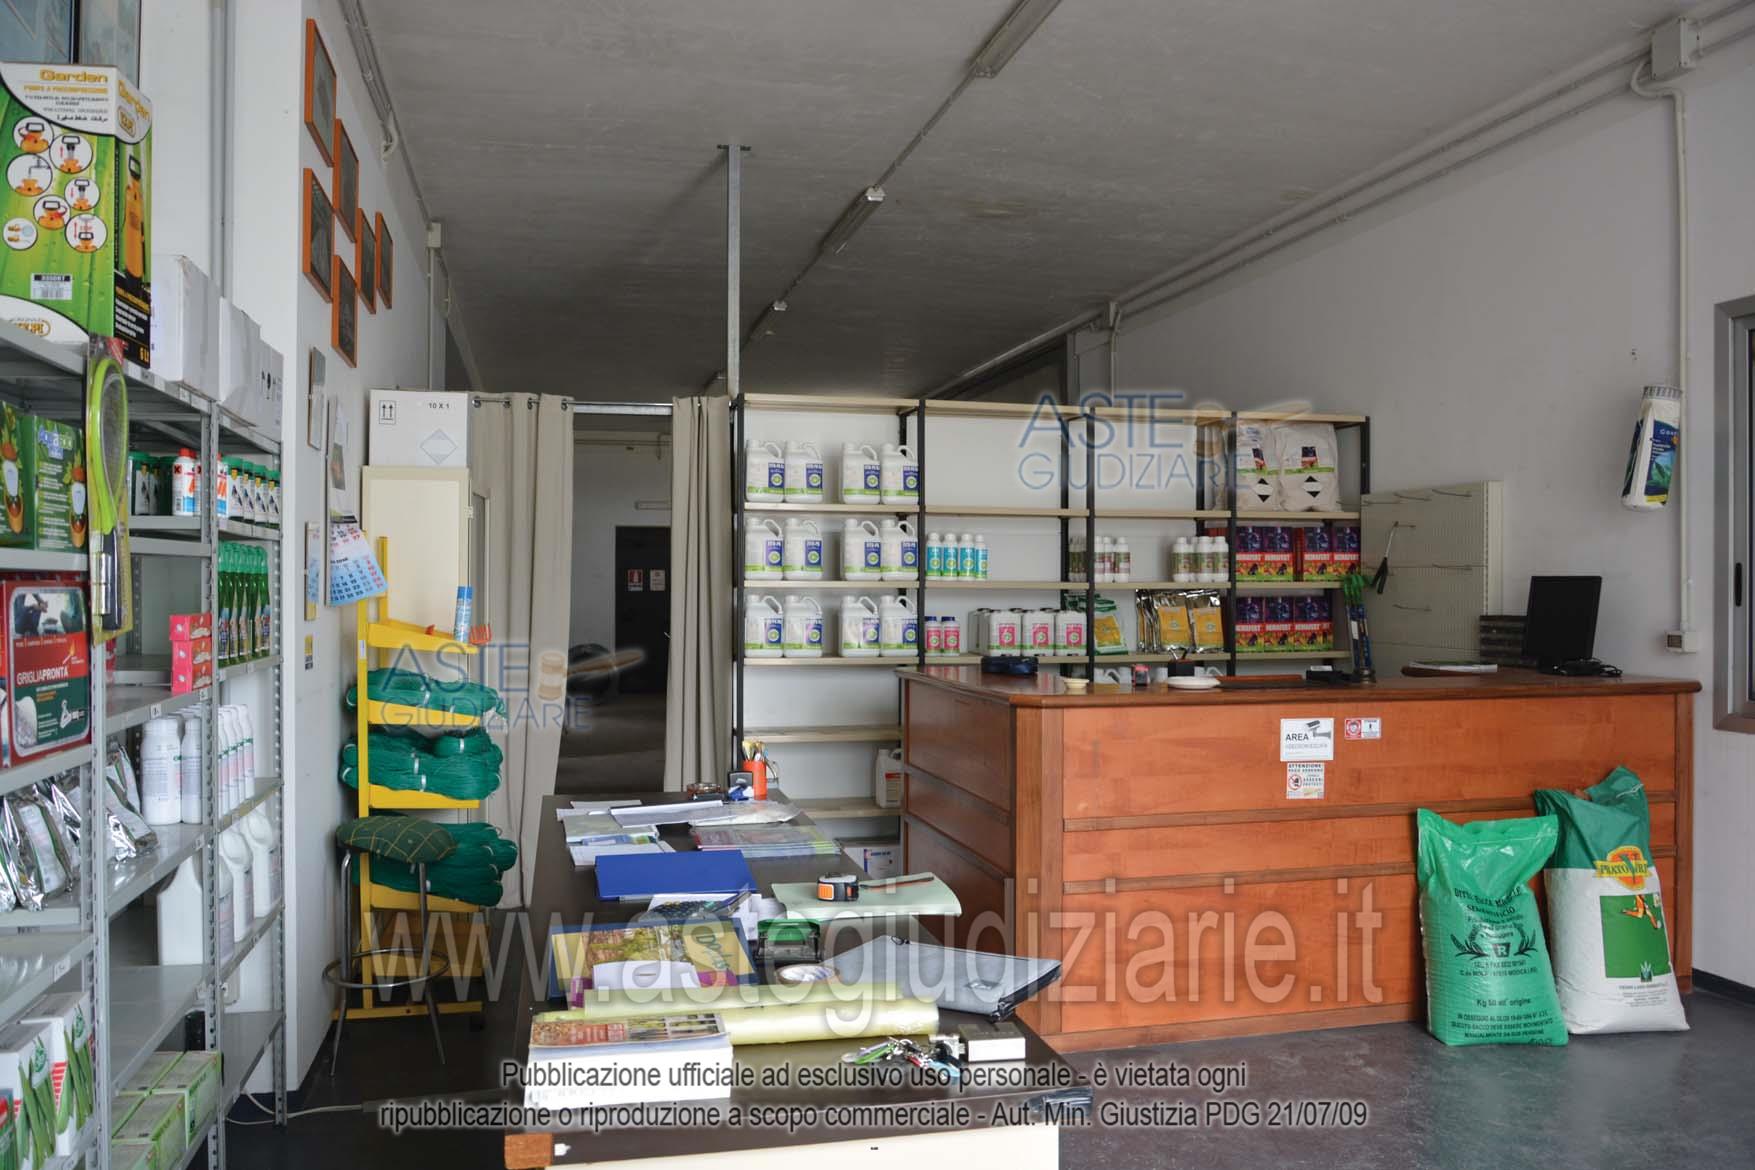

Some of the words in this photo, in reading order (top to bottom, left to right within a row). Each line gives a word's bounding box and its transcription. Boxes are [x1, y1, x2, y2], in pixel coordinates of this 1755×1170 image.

[17, 666, 69, 686] GRIGLIAPRONTA
[1285, 733, 1309, 741] AREA
[1476, 998, 1487, 1008] Kg
